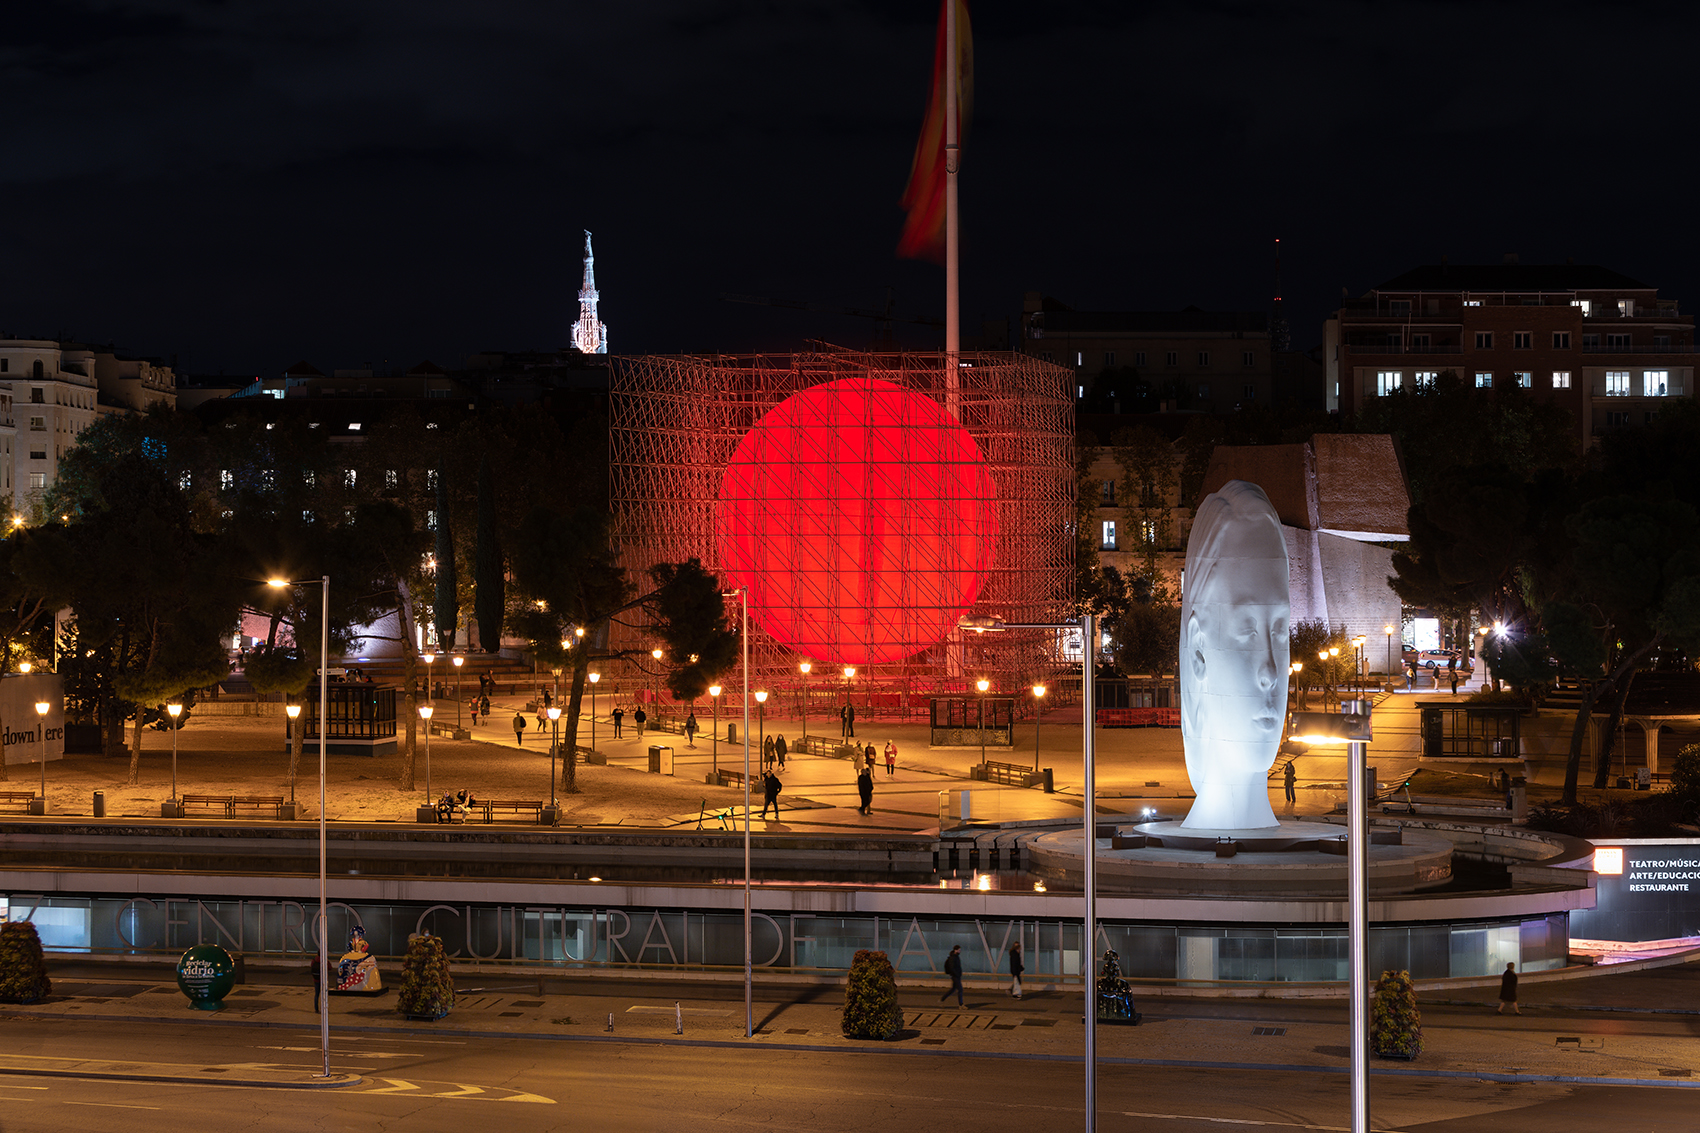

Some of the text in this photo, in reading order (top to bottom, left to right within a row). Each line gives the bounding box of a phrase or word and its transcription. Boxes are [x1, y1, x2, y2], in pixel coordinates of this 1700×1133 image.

[3, 726, 35, 745] down
[1629, 884, 1689, 892] RESTAURANTE
[115, 897, 364, 956] CENTRO
[415, 904, 701, 965] CULTURAL
[747, 912, 817, 967] DE
[183, 966, 215, 975] vidrio
